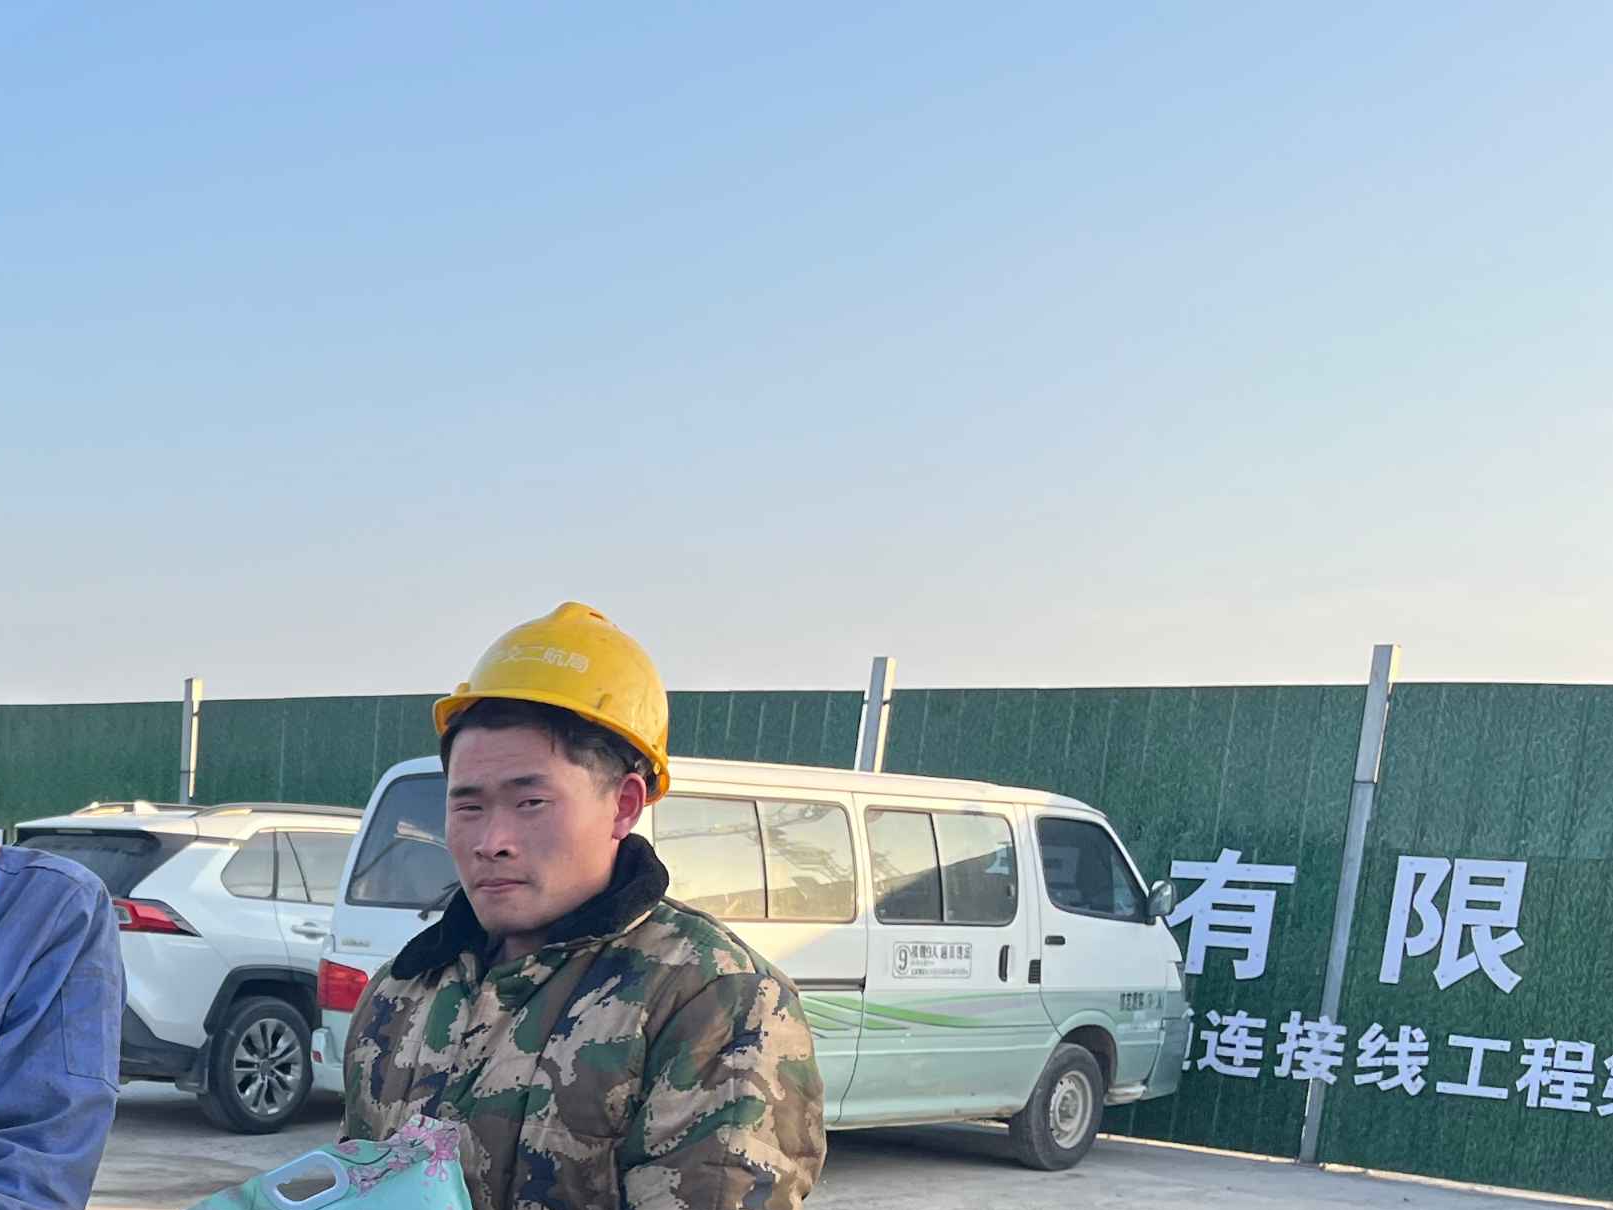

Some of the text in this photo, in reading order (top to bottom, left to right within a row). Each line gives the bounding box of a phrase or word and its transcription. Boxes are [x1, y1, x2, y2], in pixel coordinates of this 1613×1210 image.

[1167, 847, 1528, 994] 有限
[1182, 1008, 1613, 1117] 连接线工程
